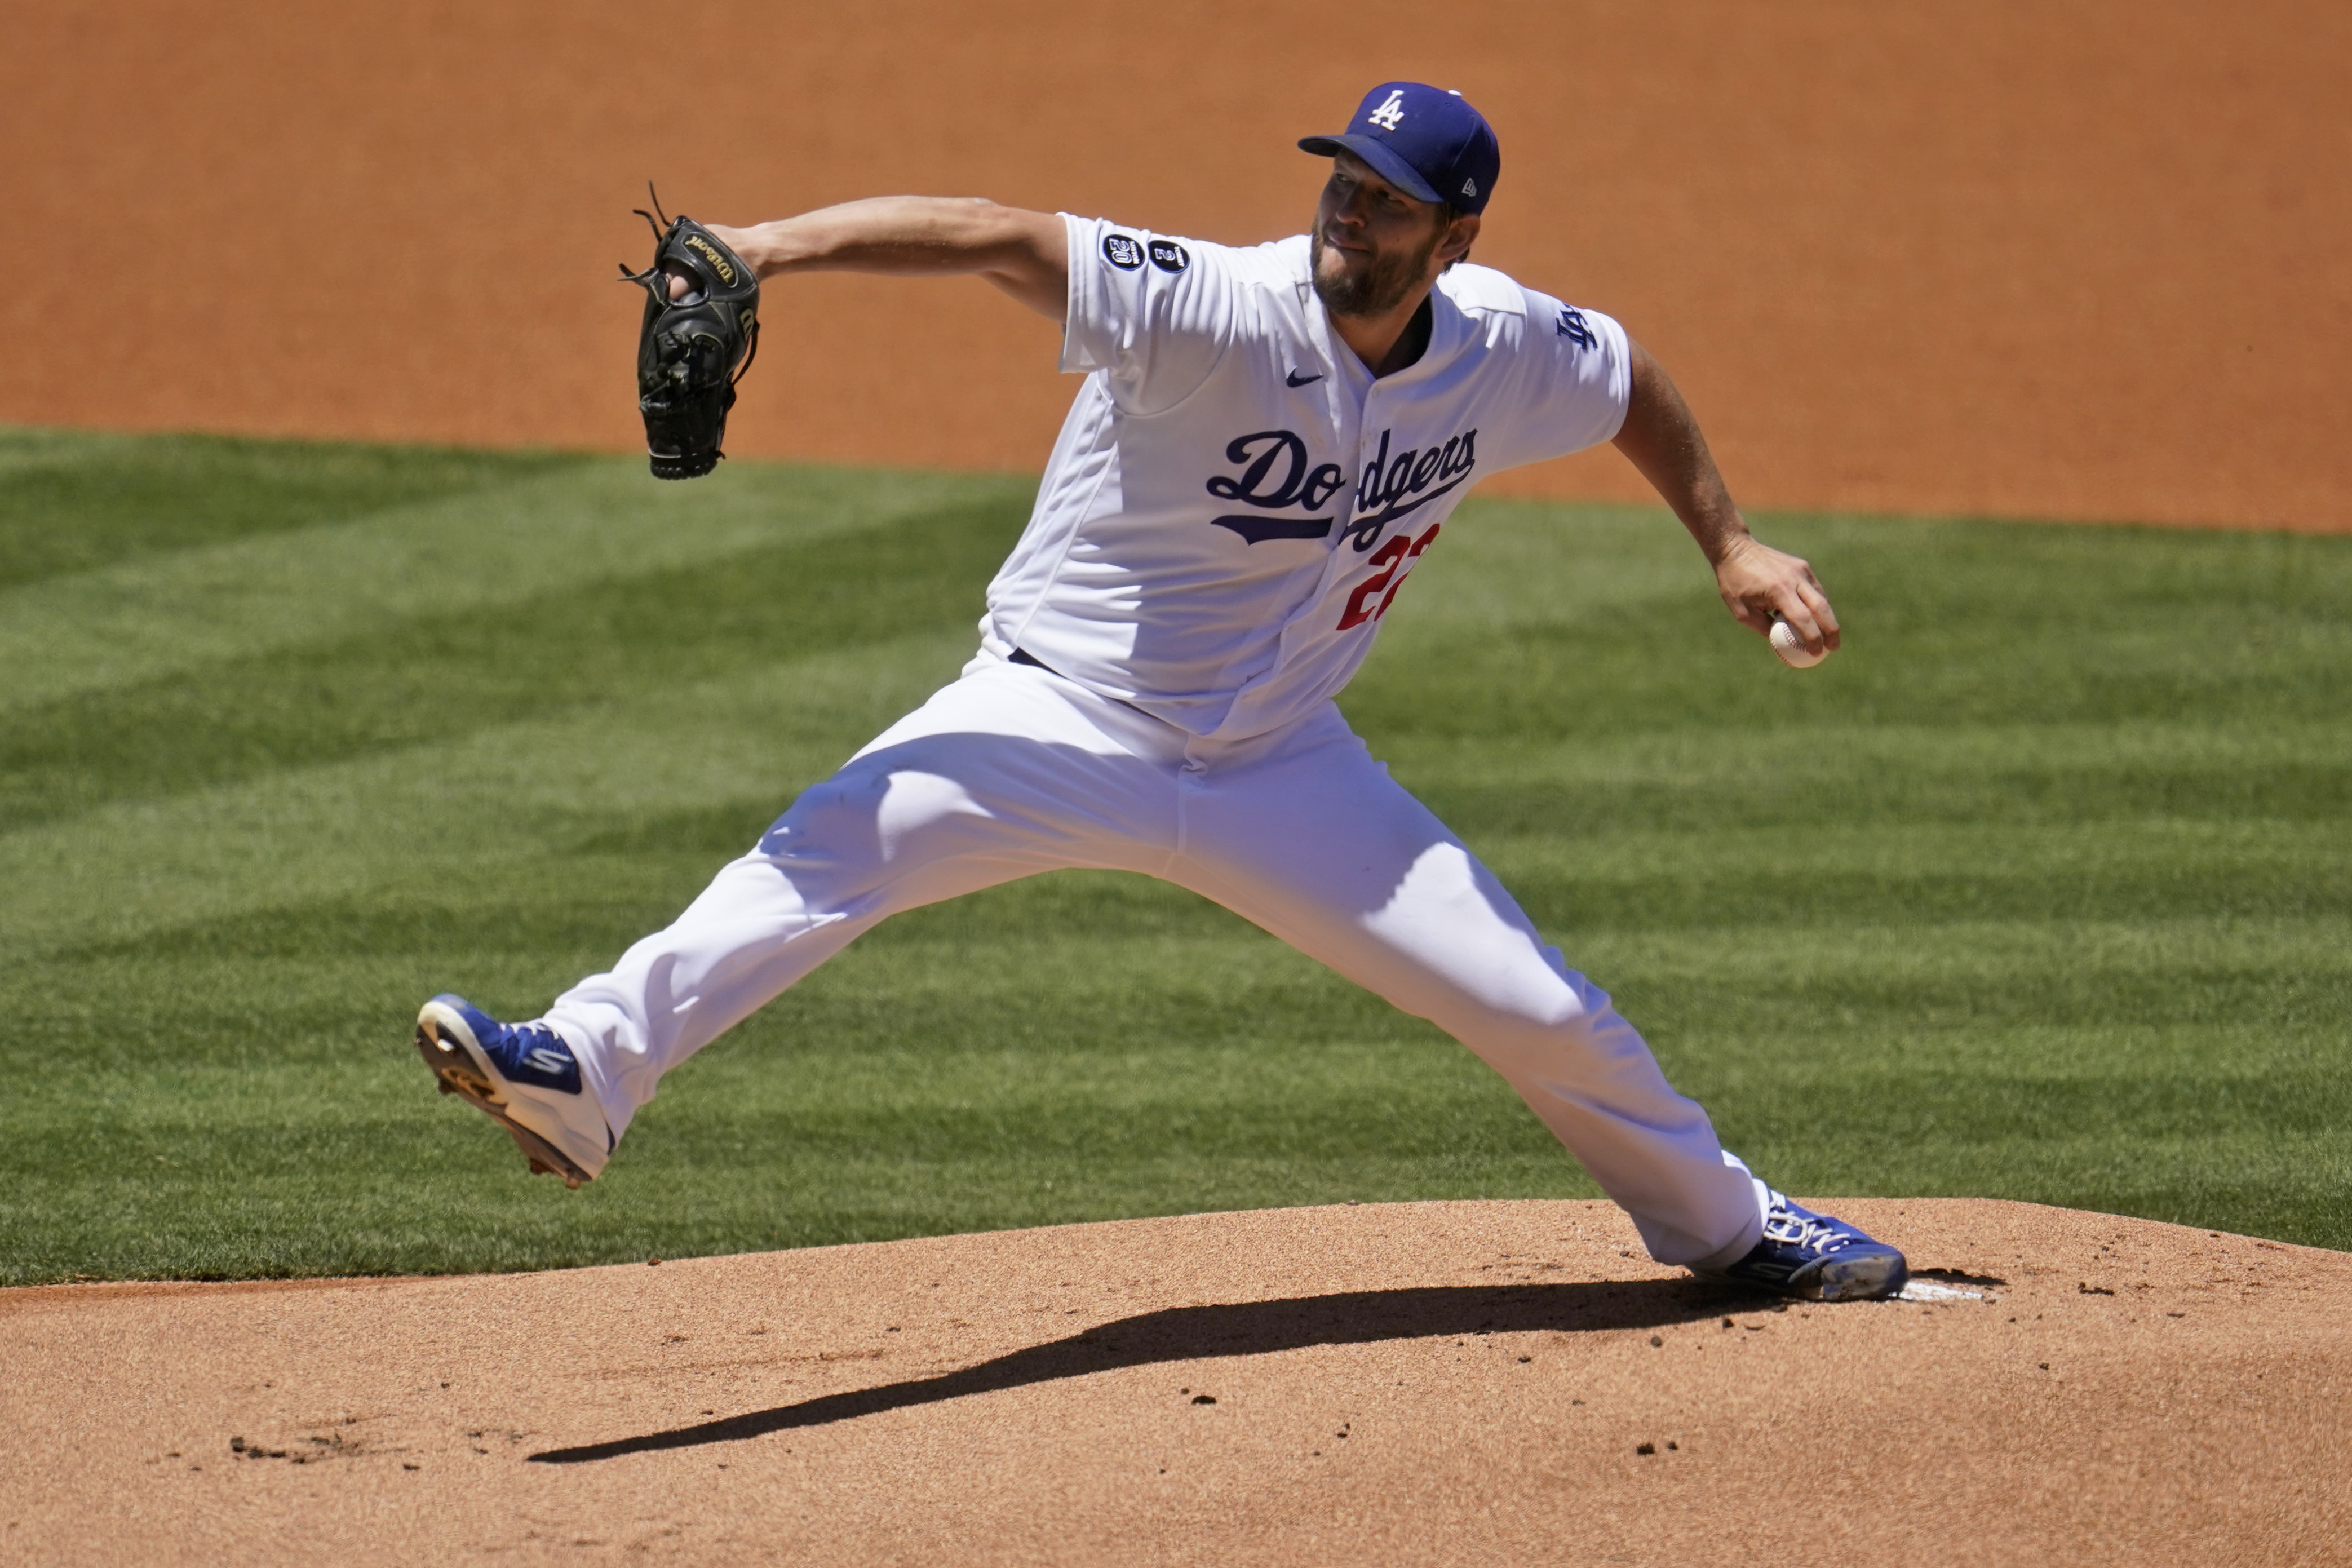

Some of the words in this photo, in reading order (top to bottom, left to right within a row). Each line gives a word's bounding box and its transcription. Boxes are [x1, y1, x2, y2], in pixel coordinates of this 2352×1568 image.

[1368, 90, 1404, 131] LA
[685, 236, 734, 282] Wilson
[1109, 238, 1133, 264] 20
[1154, 248, 1176, 261] 2
[1206, 429, 1478, 552] Dodgers
